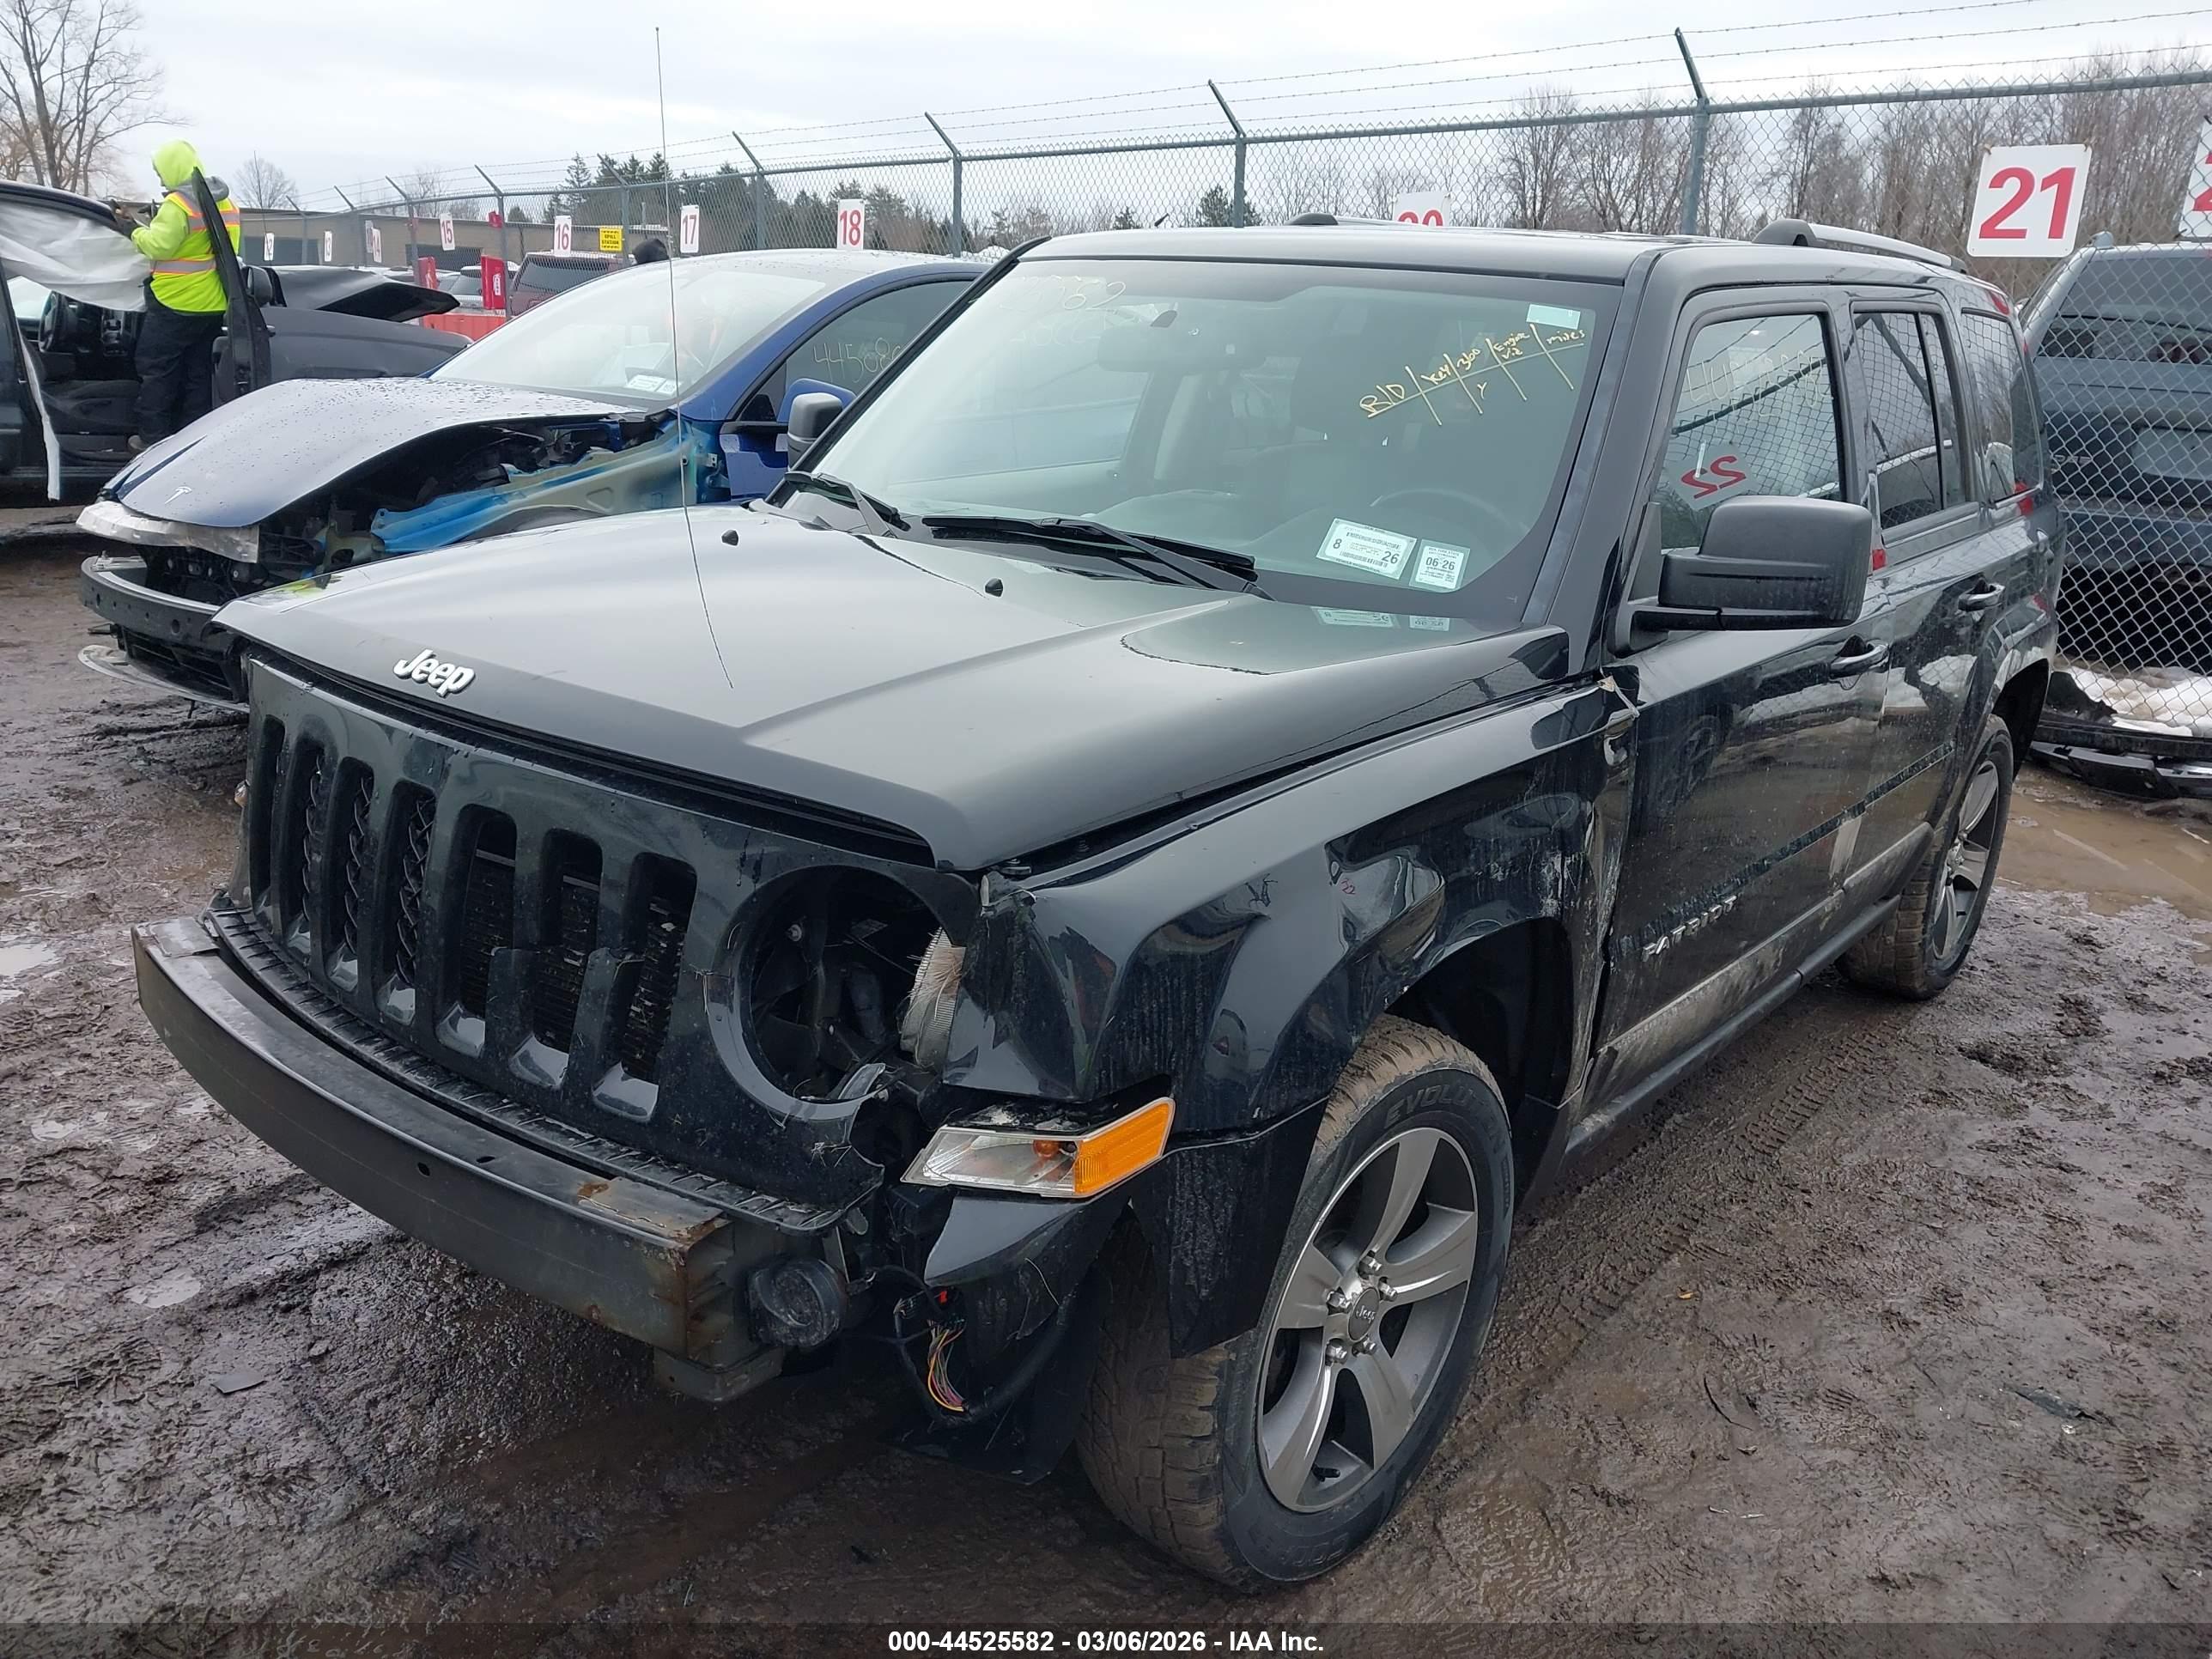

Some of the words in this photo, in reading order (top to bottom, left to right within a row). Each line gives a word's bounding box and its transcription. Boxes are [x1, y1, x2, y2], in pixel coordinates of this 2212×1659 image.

[1978, 167, 2076, 239] 21
[441, 221, 453, 244] 15
[556, 223, 569, 250] 16
[682, 215, 696, 245] 17
[839, 210, 861, 246] 18
[1333, 538, 1342, 549] 8
[1382, 550, 1400, 564] 26
[393, 648, 475, 698] Jeep
[1642, 895, 1737, 962] PATRIOT
[1355, 1304, 1377, 1325] Jeep
